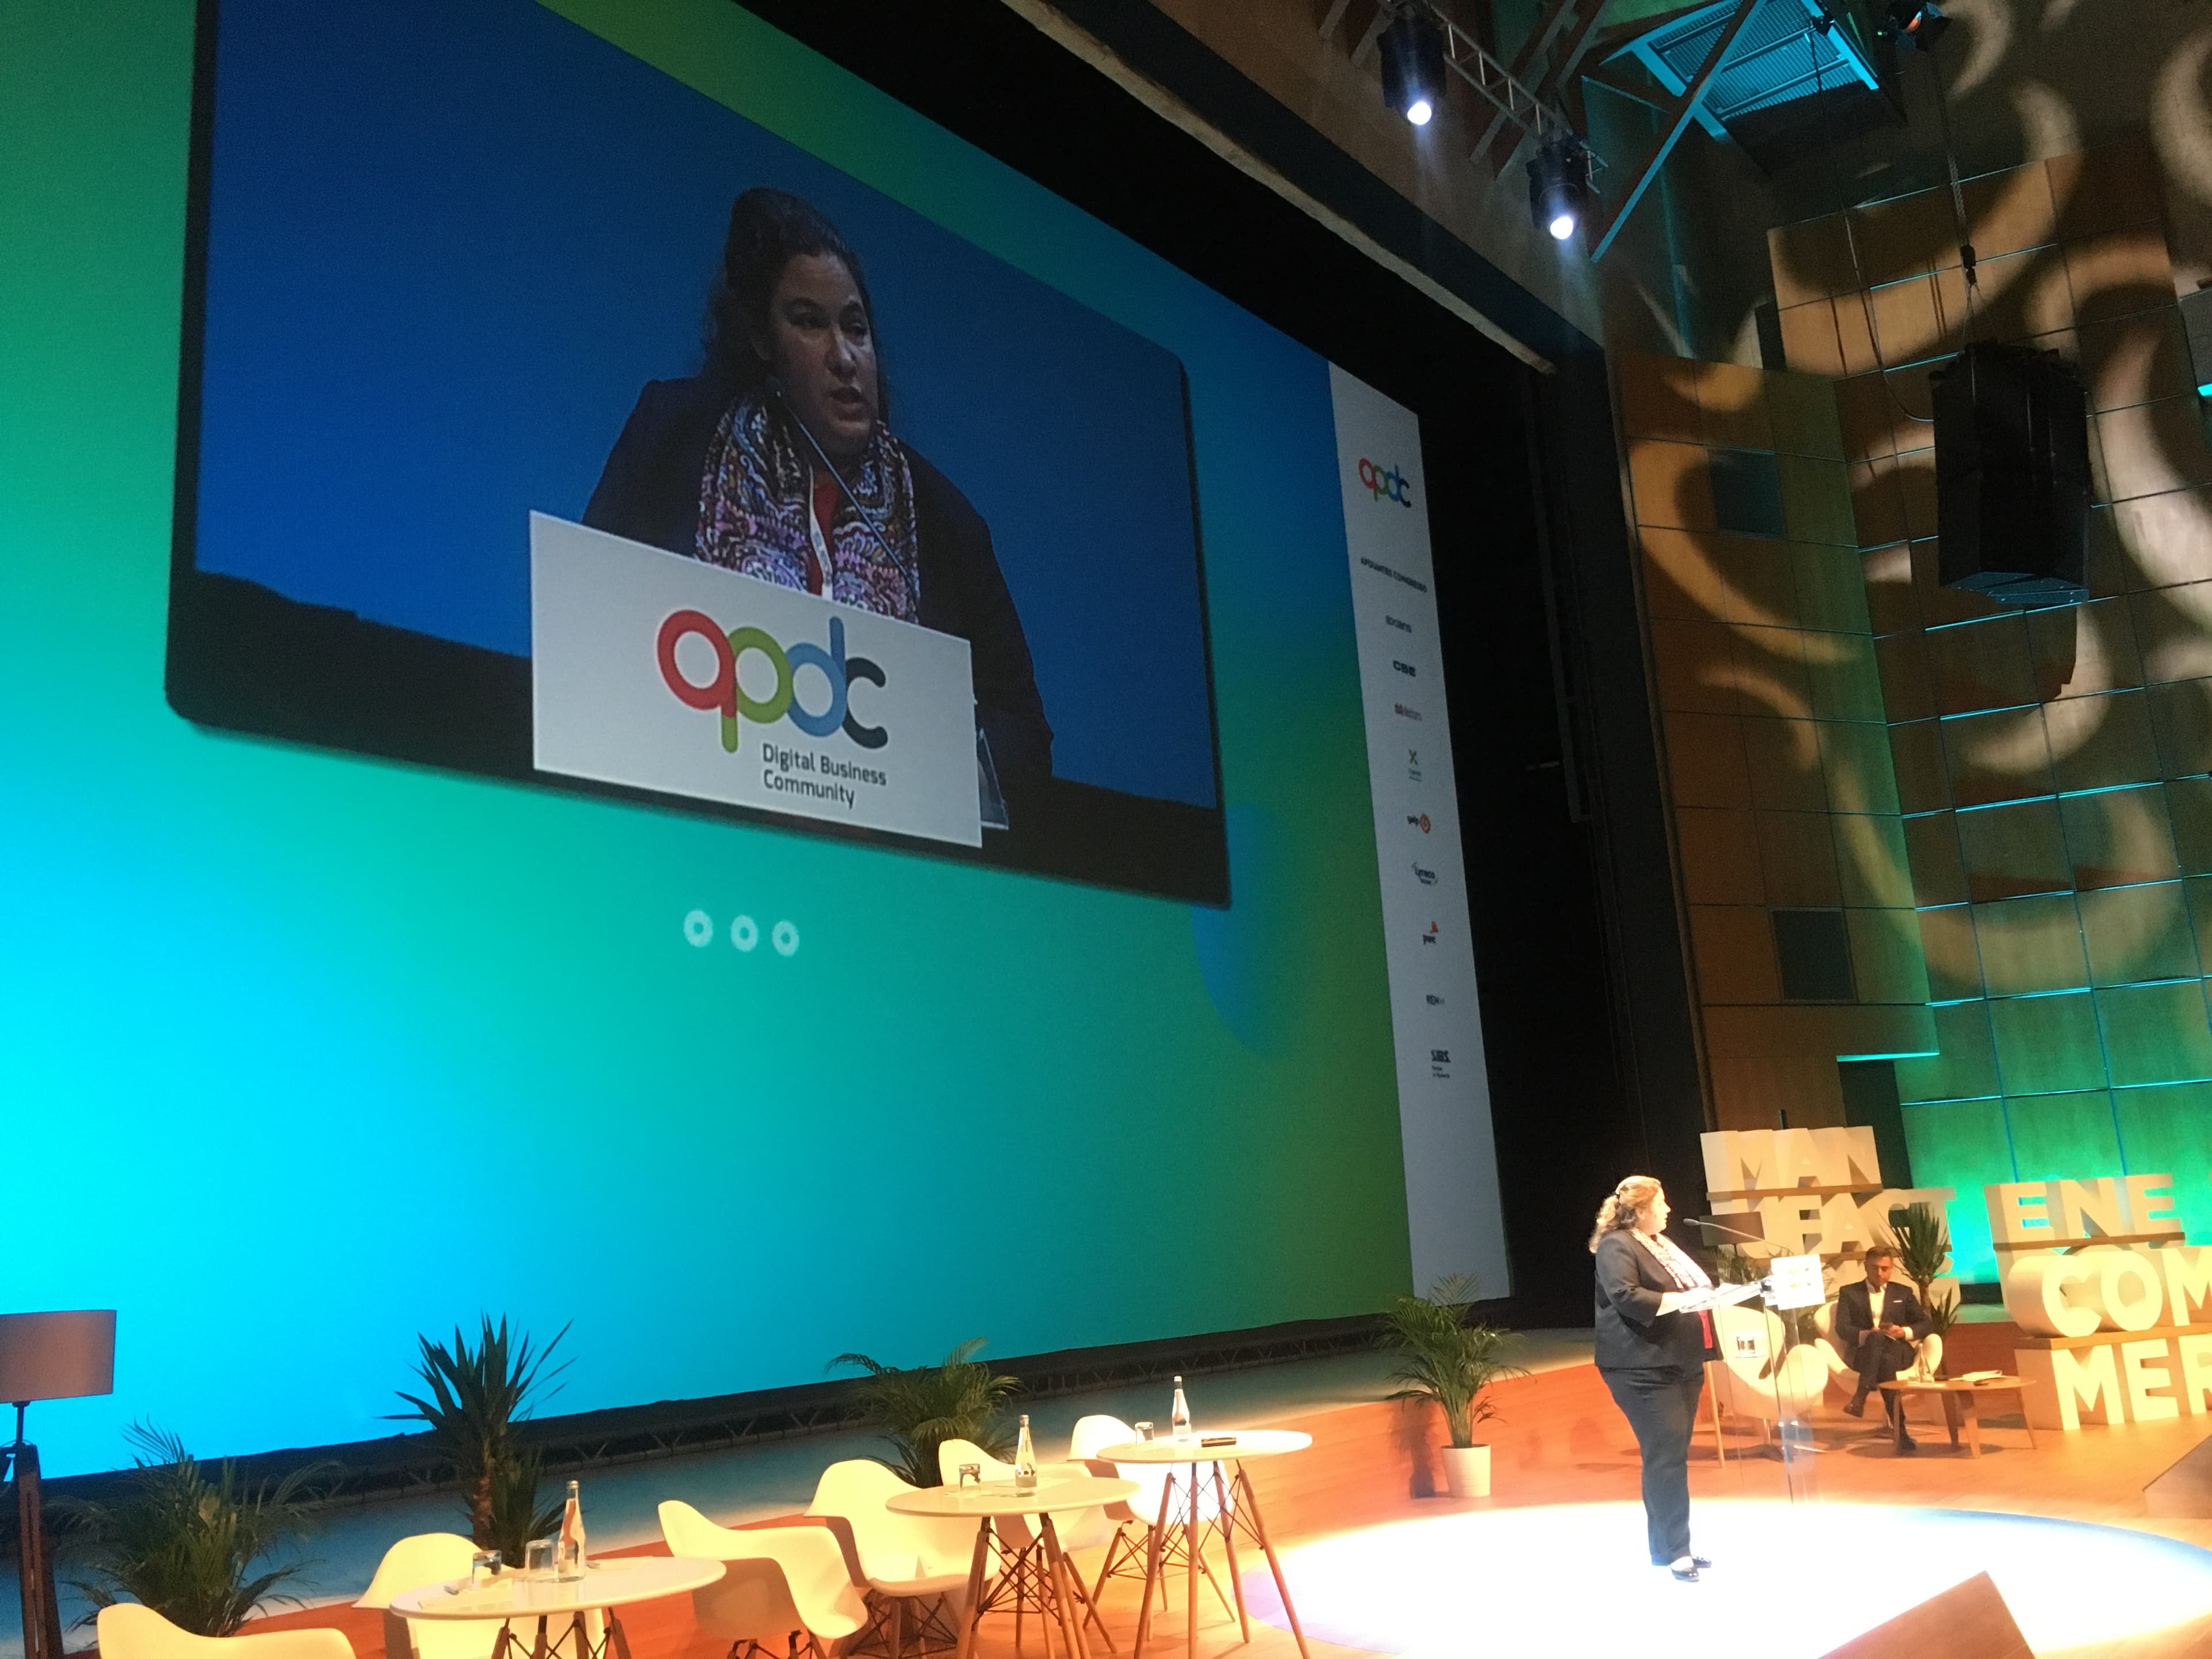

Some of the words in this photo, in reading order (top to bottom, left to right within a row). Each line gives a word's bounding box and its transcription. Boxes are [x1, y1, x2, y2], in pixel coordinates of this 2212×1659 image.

[763, 743, 816, 772] Digital
[820, 755, 887, 786] Business
[763, 769, 855, 809] Community
[1719, 1126, 1881, 1190] MAN
[1999, 1174, 2183, 1243] ENE
